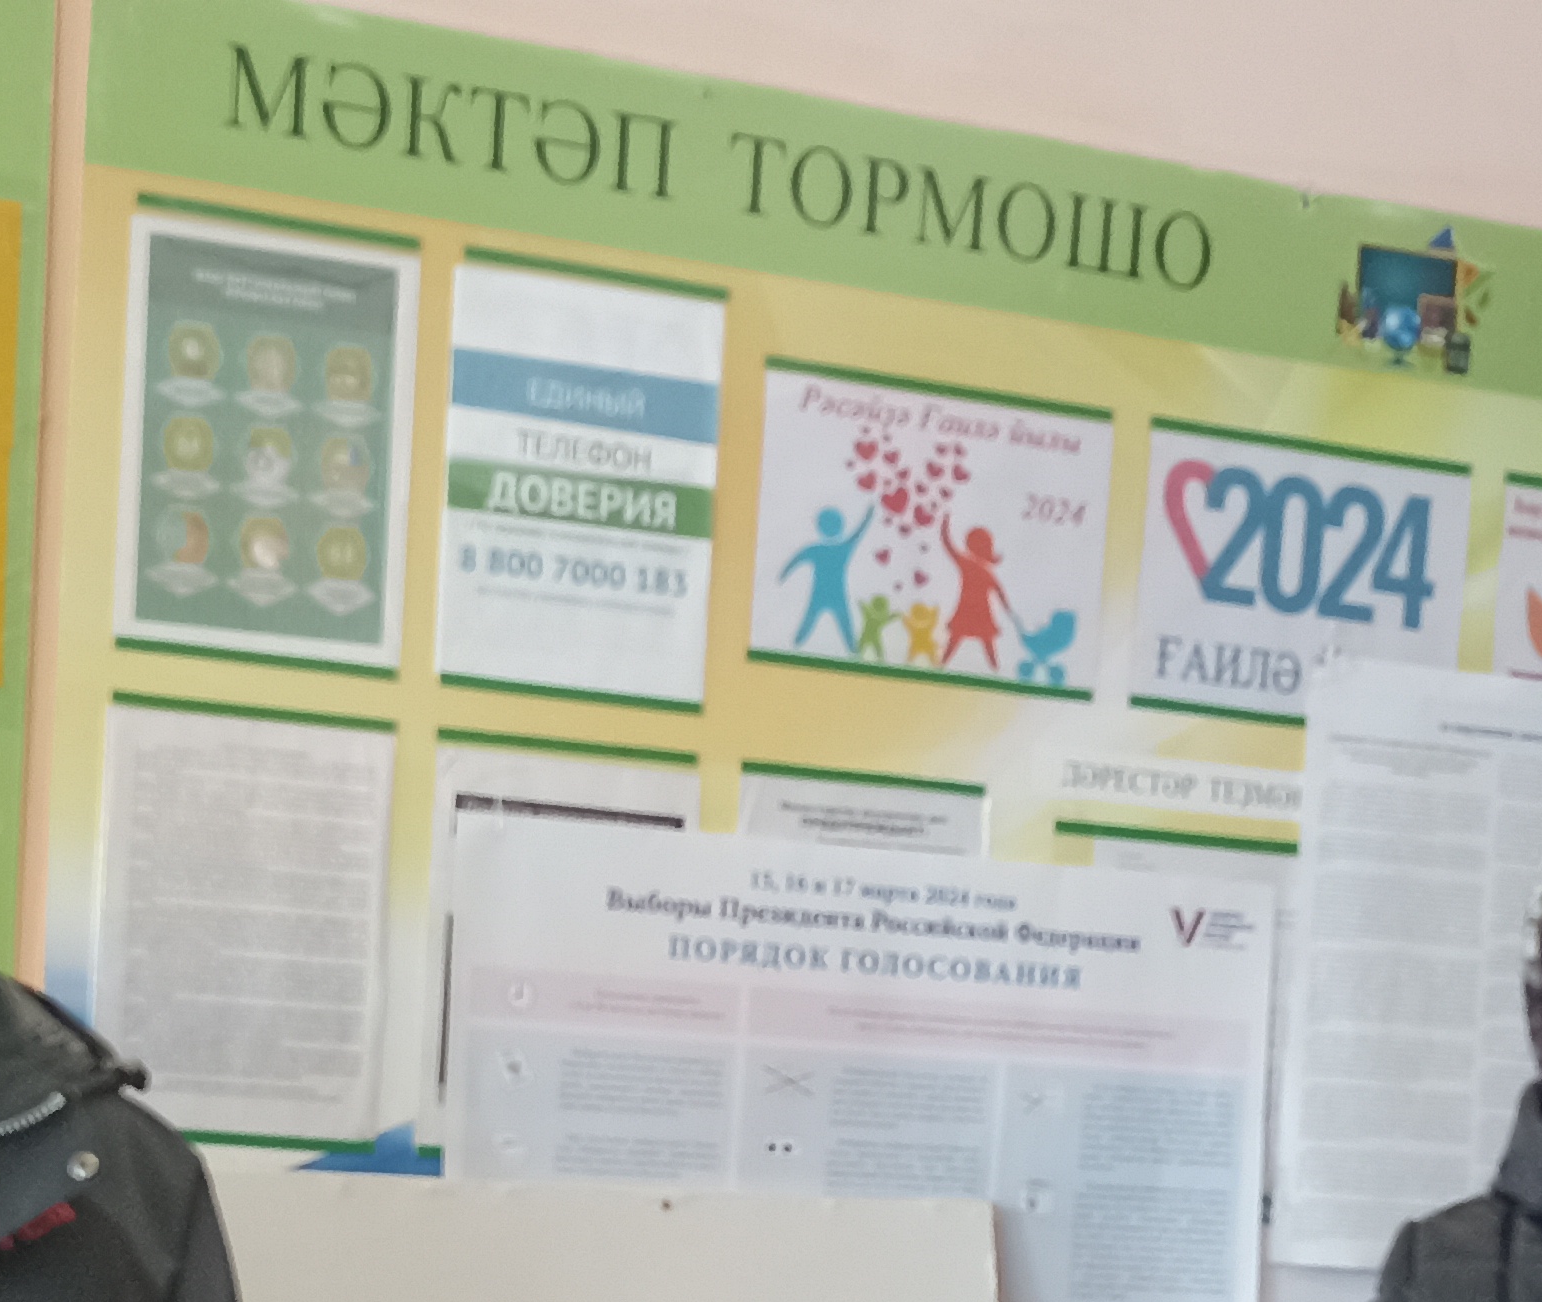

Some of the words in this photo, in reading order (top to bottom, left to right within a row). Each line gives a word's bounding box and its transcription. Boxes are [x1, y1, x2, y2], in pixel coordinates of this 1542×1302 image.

[226, 41, 679, 199] МӘКТӘП
[730, 130, 1213, 292] ТОРМОШО
[526, 377, 646, 419] ЕДИНЫЙ
[518, 427, 653, 472] ТЕЛЕФОН
[488, 472, 677, 530] ДОВЕРИЯ
[1022, 491, 1086, 525] 2024
[488, 547, 543, 581] 800
[554, 555, 626, 590] 7000
[1201, 464, 1435, 632] 2024
[606, 886, 712, 923] Выборы
[719, 896, 865, 929] Президента
[871, 908, 1009, 941] Российской
[669, 932, 828, 972] ПОРЯДОК
[840, 948, 1083, 990] ГОЛОСОВАНИЯ
